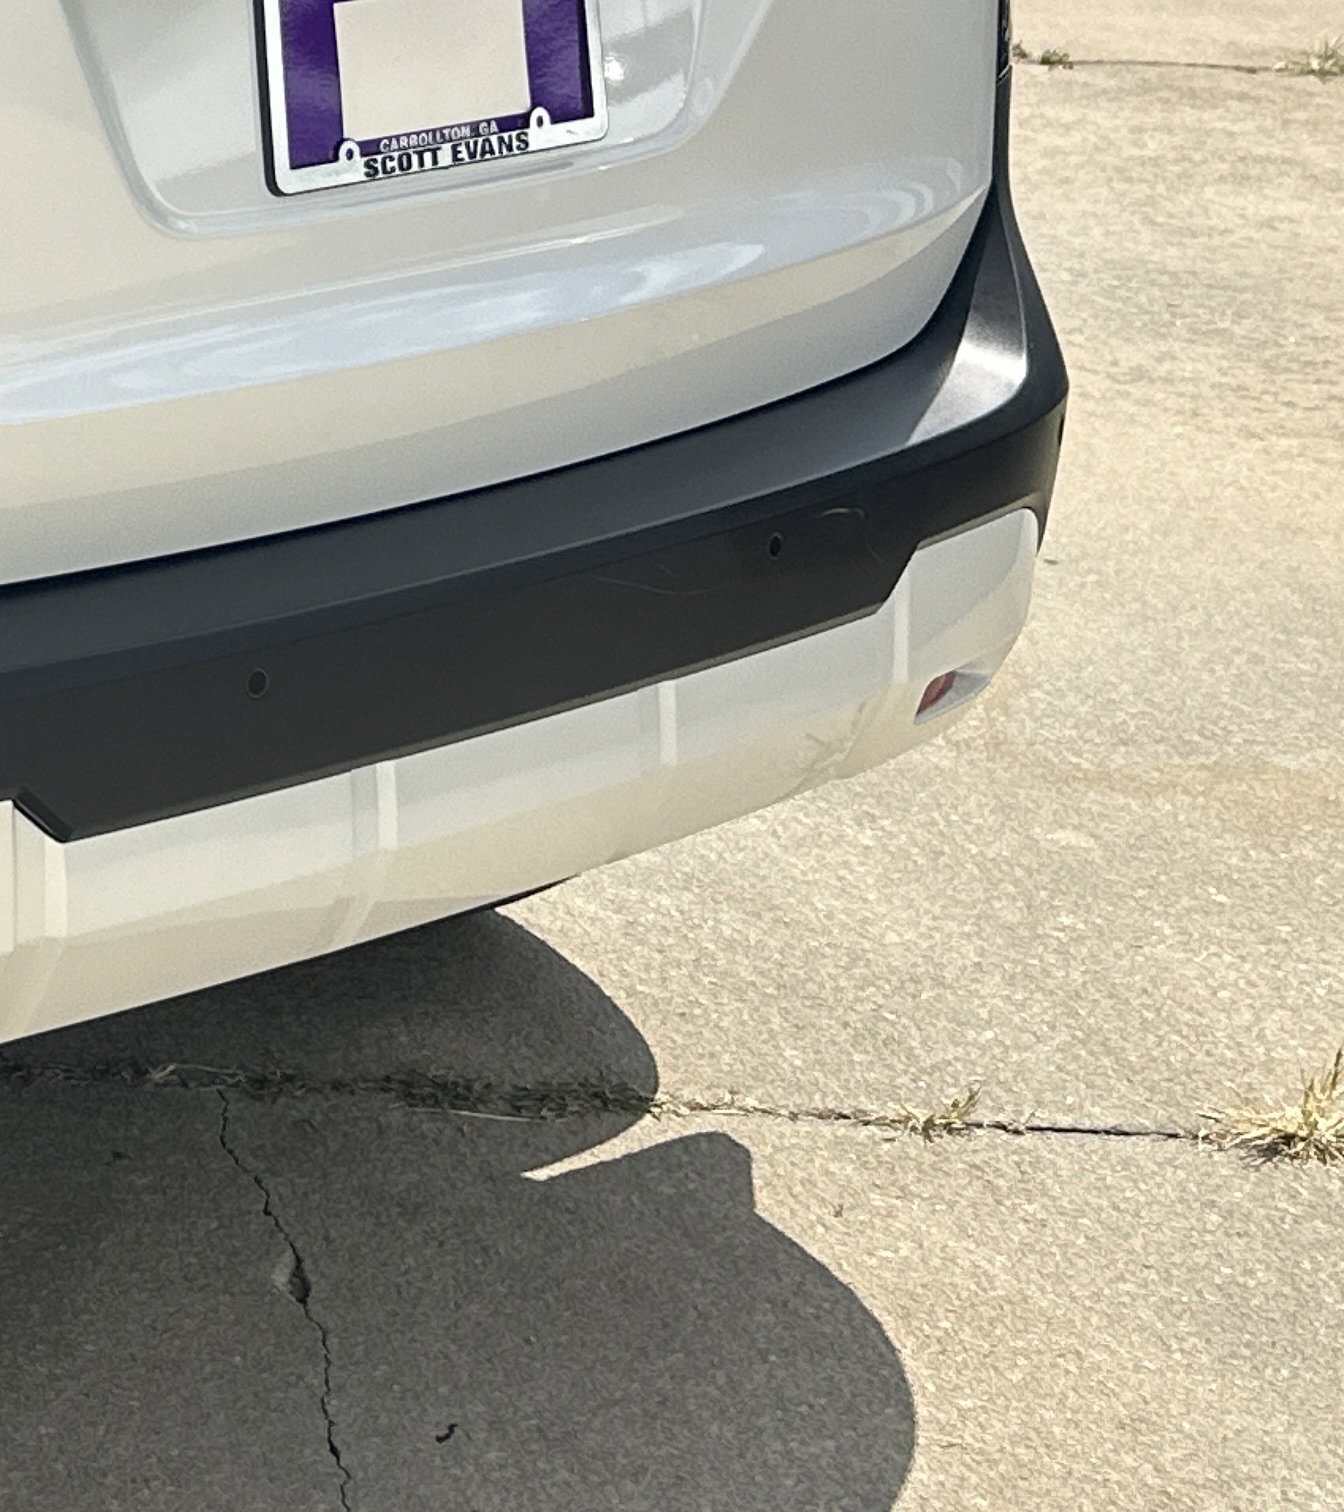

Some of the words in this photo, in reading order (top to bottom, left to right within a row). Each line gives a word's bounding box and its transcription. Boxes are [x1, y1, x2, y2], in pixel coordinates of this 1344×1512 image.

[478, 120, 499, 136] GA
[363, 146, 442, 178] SCOTT
[450, 131, 529, 164] EVANS
